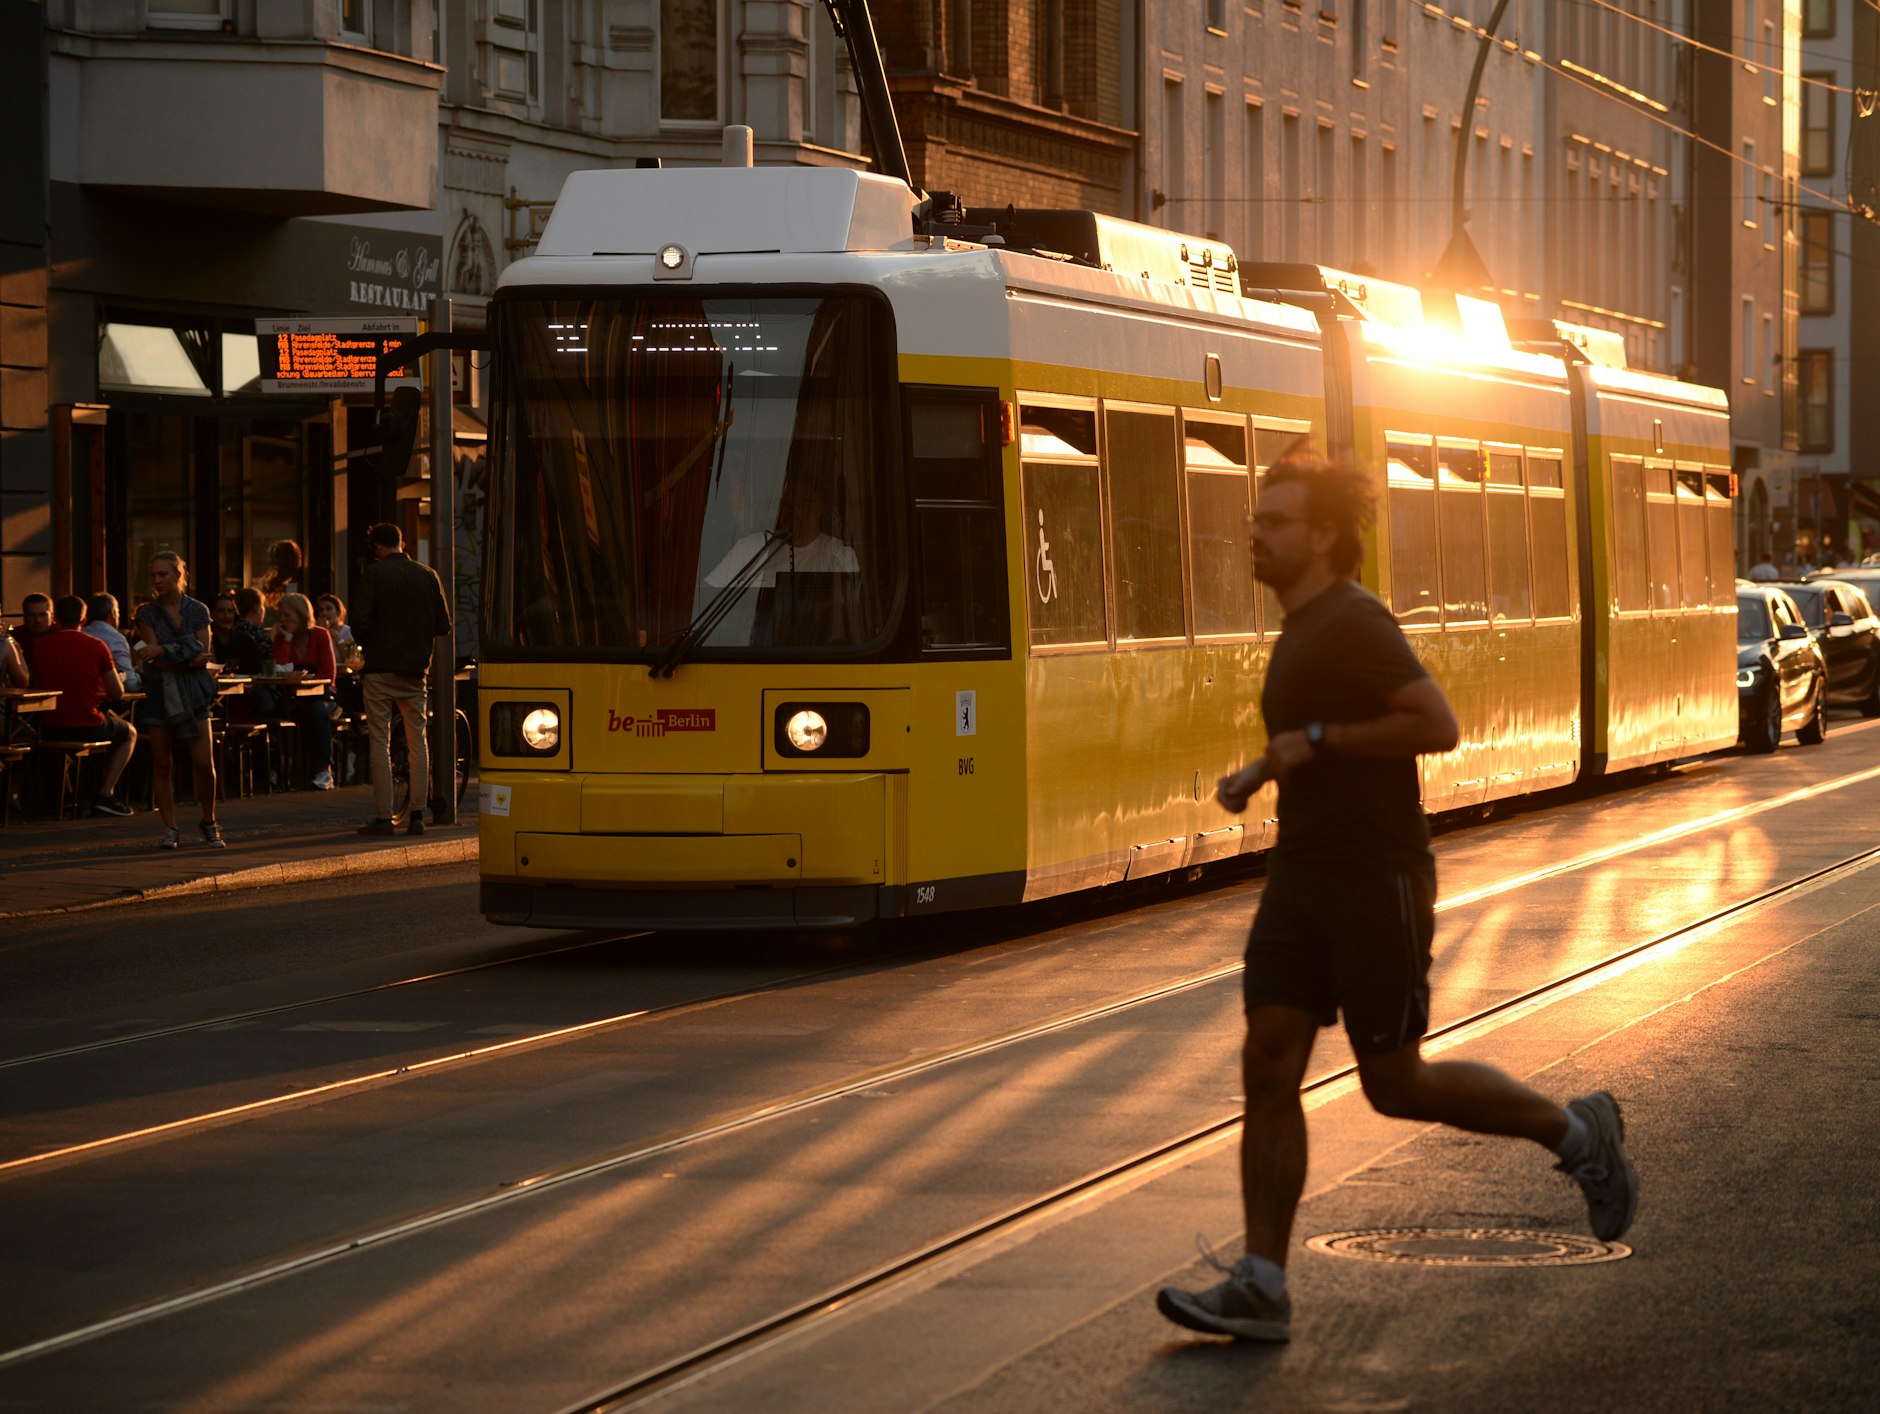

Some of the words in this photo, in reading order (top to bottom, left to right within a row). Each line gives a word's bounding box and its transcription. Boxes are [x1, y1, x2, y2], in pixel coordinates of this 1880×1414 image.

[413, 246, 439, 289] Grill
[362, 323, 391, 331] Abfahrt
[392, 323, 400, 331] in
[291, 333, 337, 342] Pasedagplatz
[292, 348, 338, 356] Pasedagplatz
[608, 709, 634, 731] be
[668, 714, 709, 727] Berlin
[959, 758, 974, 775] BVG
[917, 886, 935, 903] 1548
